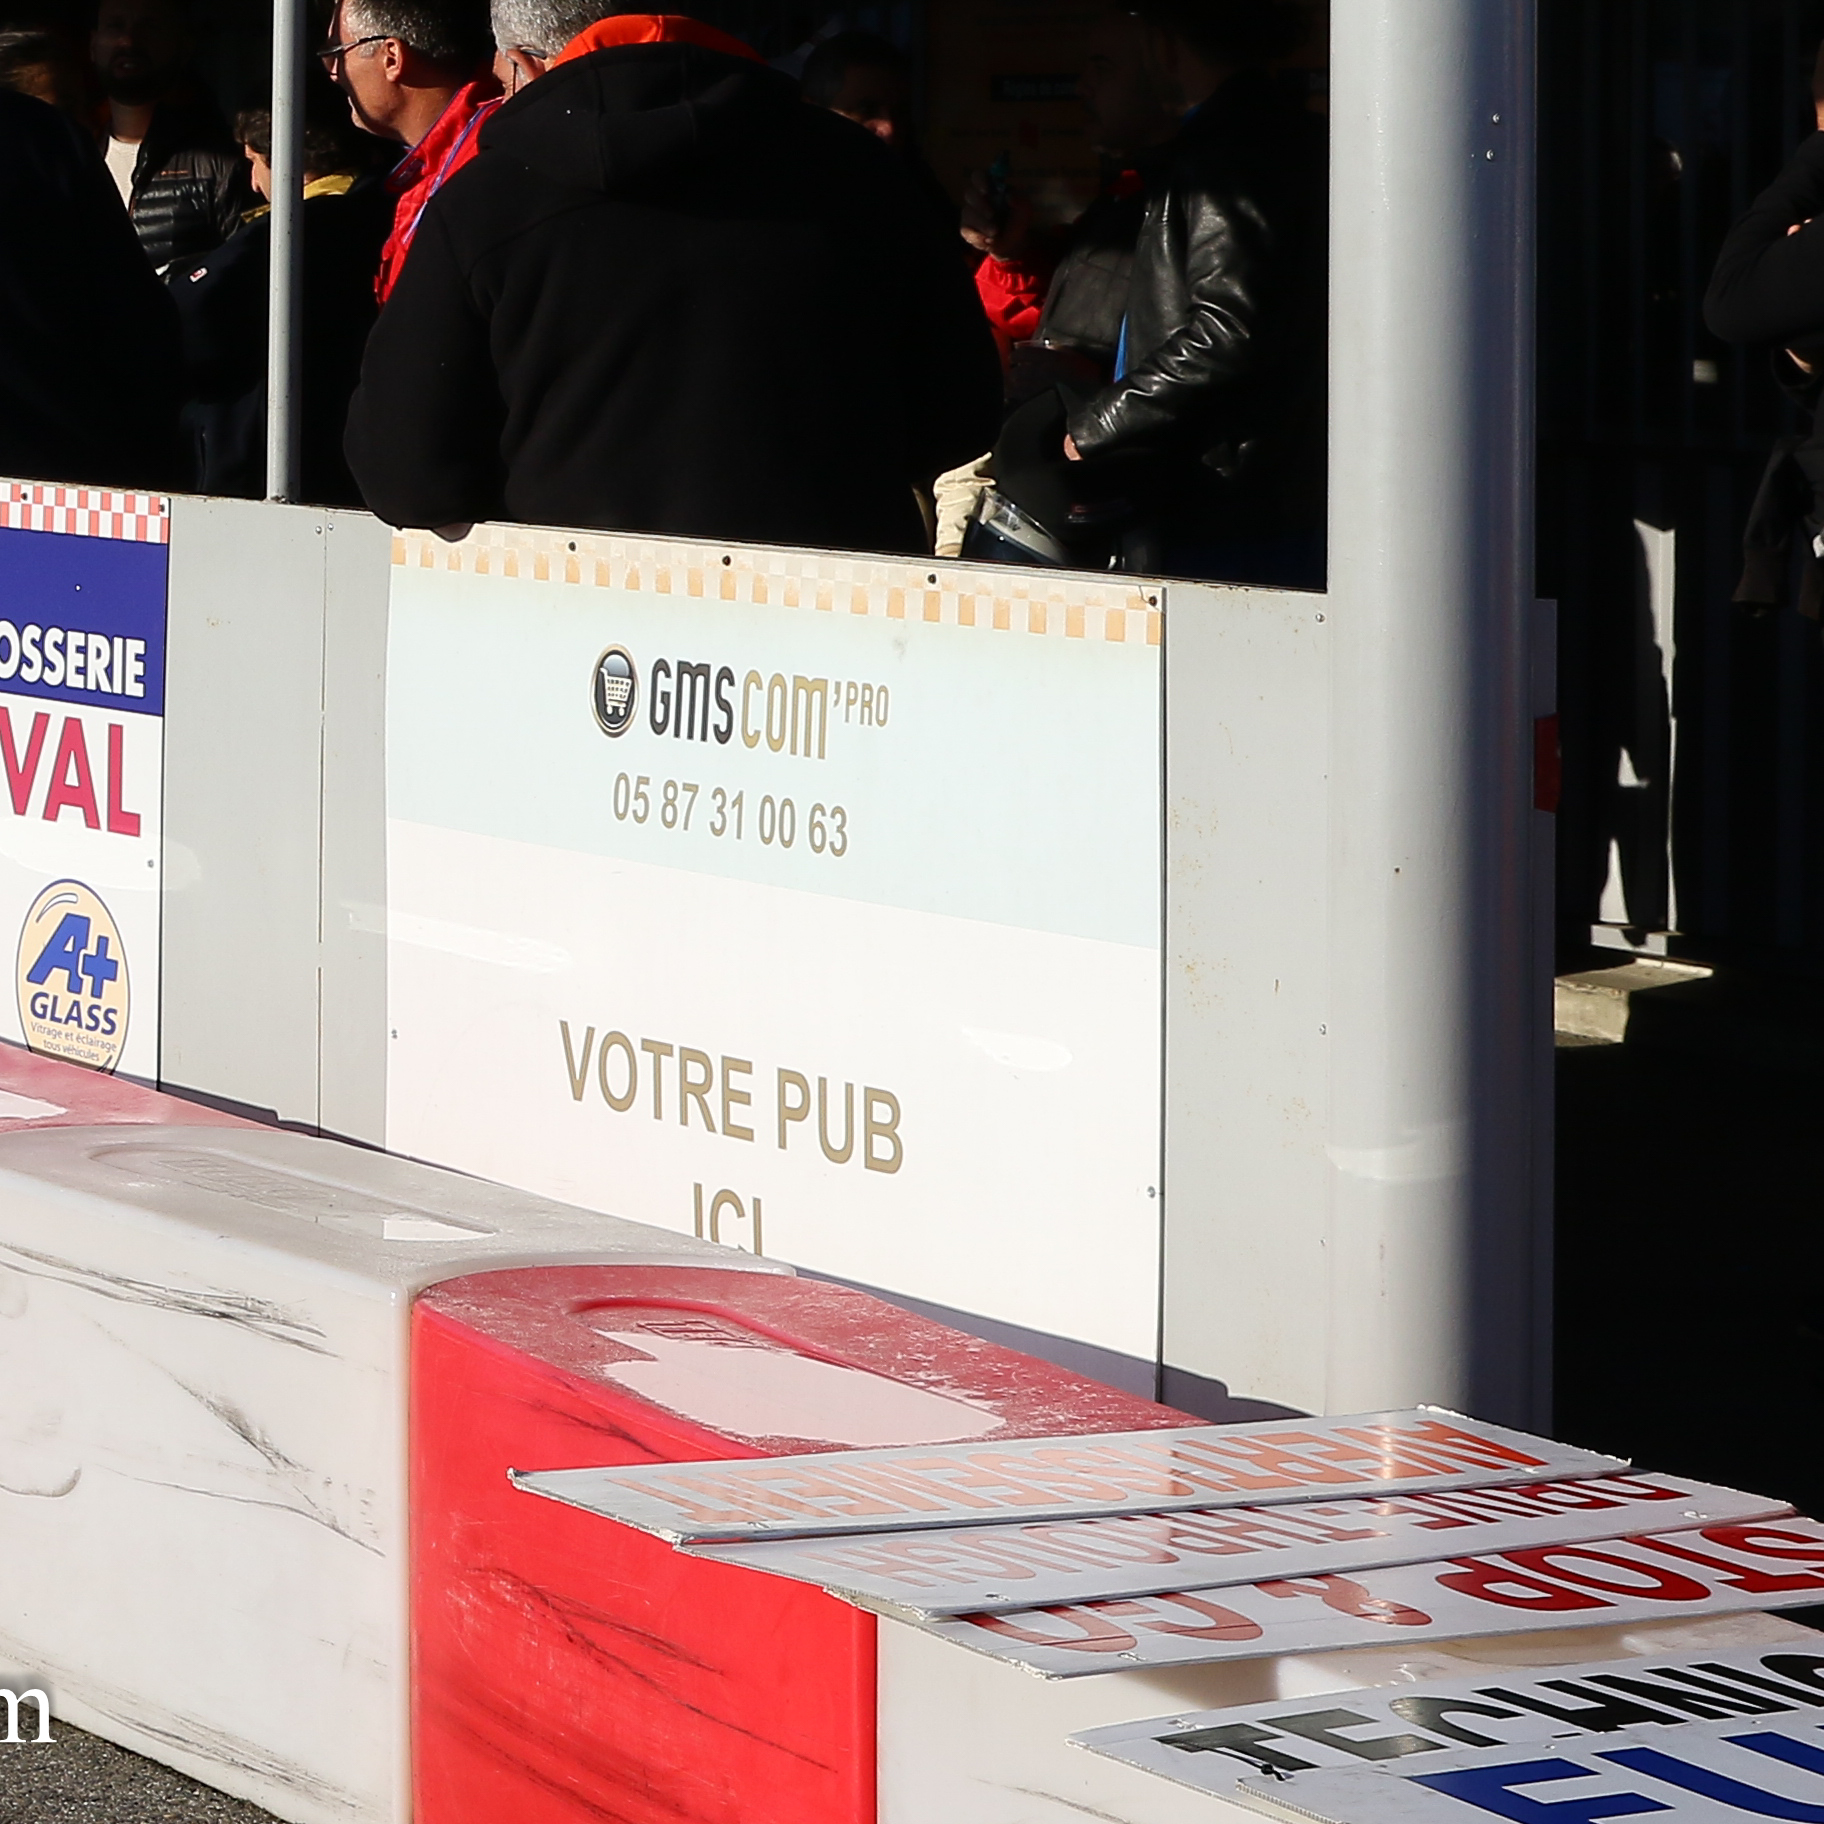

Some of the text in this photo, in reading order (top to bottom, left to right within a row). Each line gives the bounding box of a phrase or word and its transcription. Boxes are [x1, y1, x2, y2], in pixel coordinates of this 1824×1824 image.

[613, 772, 848, 857] 05 87 31 00 63
[26, 912, 118, 999] A+
[30, 991, 118, 1036] GLASS
[30, 1021, 118, 1053] Vitrage et éclairage
[43, 1038, 100, 1062] tous véhicules
[559, 1019, 904, 1174] VOTRE PUB
[693, 1182, 763, 1257] ICI
[606, 1420, 1549, 1524] AVERTISSEMENT
[796, 1476, 1693, 1587] DRIVE-THROUGH
[955, 1526, 1824, 1653] STOP & GO
